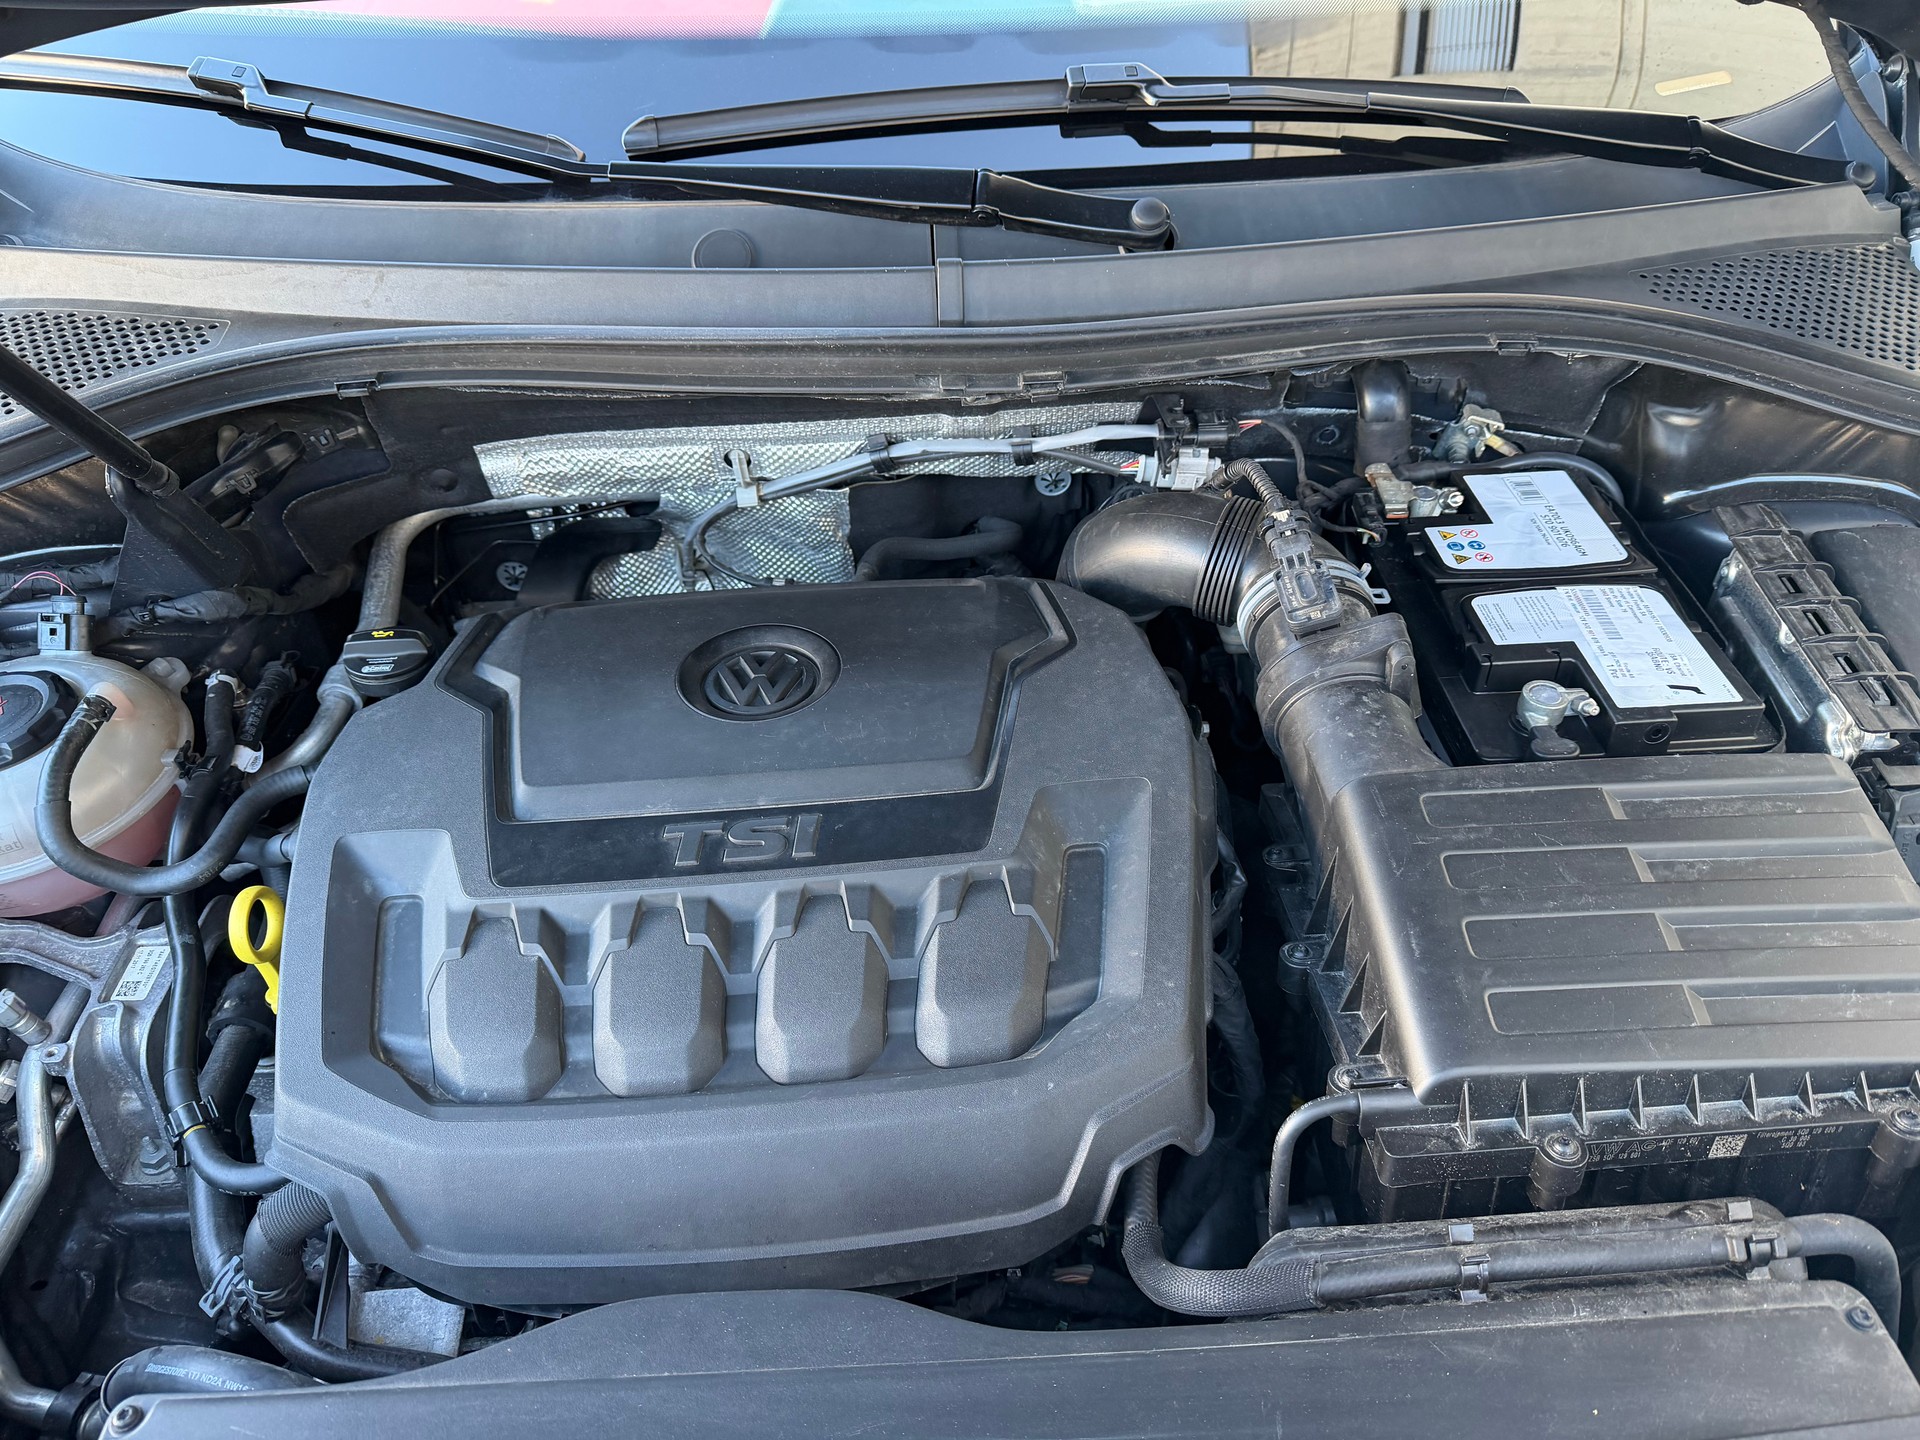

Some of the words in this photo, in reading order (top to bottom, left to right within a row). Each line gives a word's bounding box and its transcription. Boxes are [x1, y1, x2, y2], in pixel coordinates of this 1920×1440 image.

[662, 813, 822, 868] TSI
[1590, 1141, 1624, 1156] VW
[1626, 1140, 1656, 1153] AG
[144, 1362, 188, 1378] BRIDGESTONE
[200, 1373, 223, 1386] ND2A
